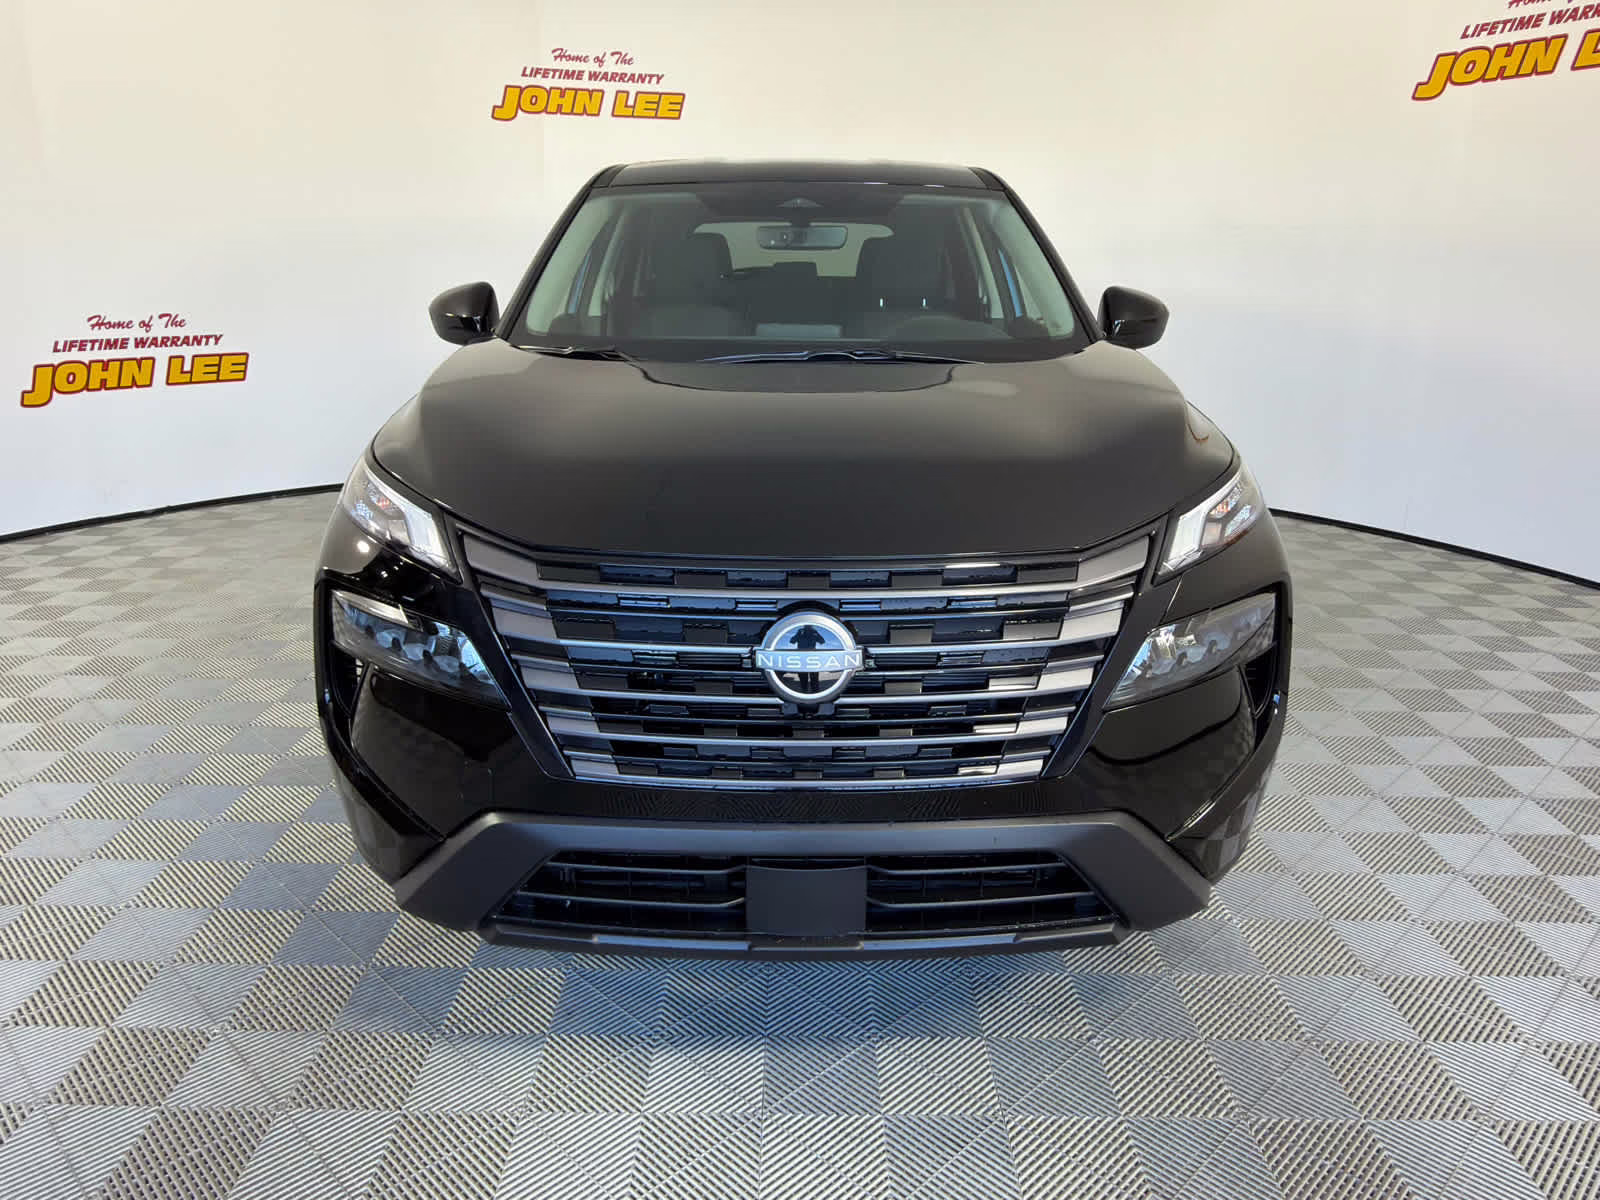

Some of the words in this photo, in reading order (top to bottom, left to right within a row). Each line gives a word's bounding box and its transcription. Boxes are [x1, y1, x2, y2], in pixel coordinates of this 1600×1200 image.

[1460, 13, 1546, 39] LIFETIME
[551, 47, 590, 63] Home
[593, 52, 606, 67] of
[610, 51, 634, 66] The
[1412, 33, 1568, 100] JOHN
[521, 66, 584, 81] LIFETIME
[588, 70, 664, 85] WARRANTY
[491, 85, 604, 121] JOHN
[611, 90, 685, 119] LEE
[87, 314, 133, 331] Home
[138, 315, 153, 332] of
[158, 313, 186, 329] The
[53, 337, 129, 353] LIFETIME
[134, 334, 223, 349] WARRANTY
[20, 357, 155, 408] JOHN
[165, 352, 249, 385] LEE
[757, 653, 860, 668] NISSAN
